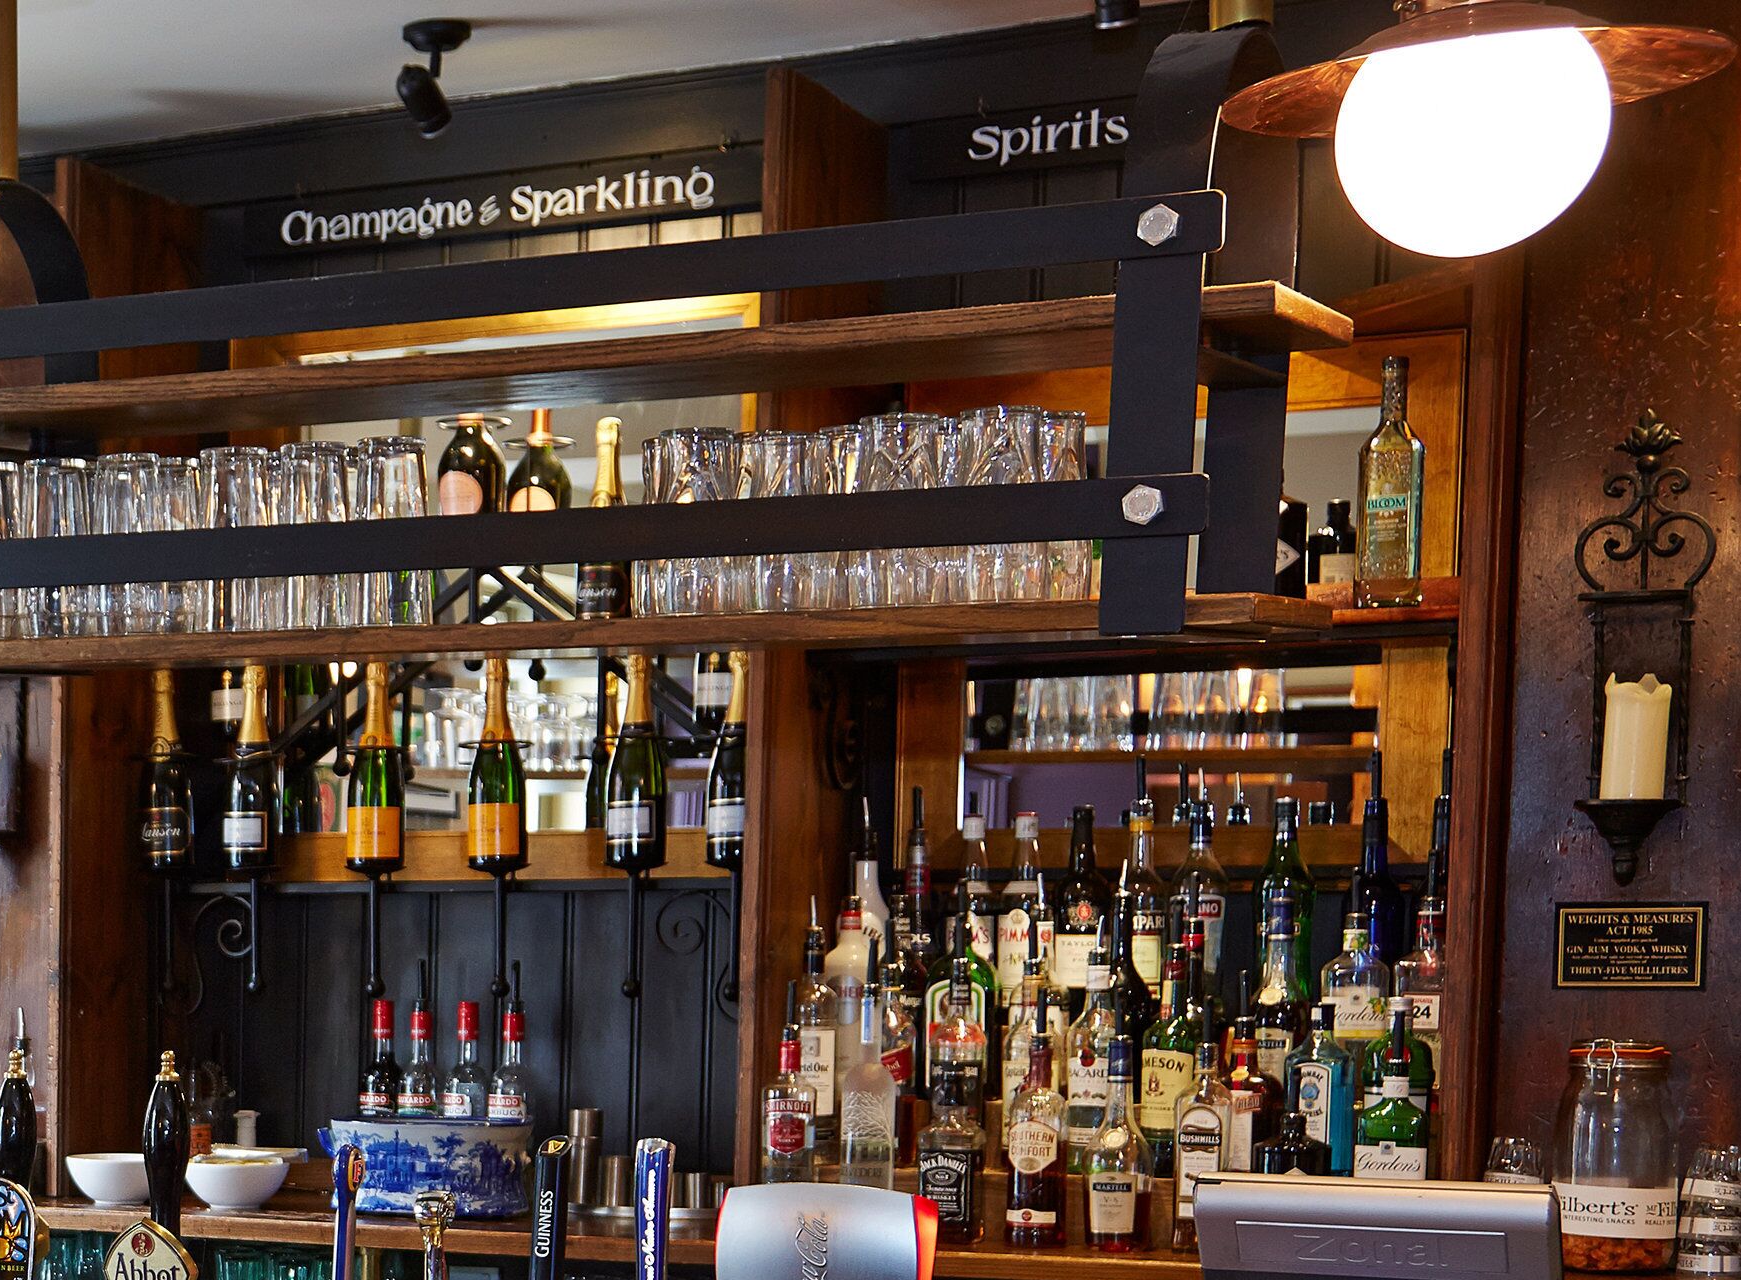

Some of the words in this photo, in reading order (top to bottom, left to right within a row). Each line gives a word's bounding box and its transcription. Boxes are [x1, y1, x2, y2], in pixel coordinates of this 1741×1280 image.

[281, 197, 473, 246] Champagne
[510, 165, 715, 227] Sparkling
[1368, 498, 1406, 509] BLOOM
[141, 822, 180, 841] Lanson
[1568, 914, 1619, 923] WEIGHTS
[1621, 914, 1630, 923] &
[1634, 914, 1694, 923] MEASURES
[999, 928, 1029, 942] PIMM
[1606, 926, 1631, 935] ACT
[1632, 926, 1653, 935] 1985
[1567, 946, 1583, 954] GIN
[1614, 945, 1646, 953] VODKA
[1651, 945, 1688, 953] WHISKY
[1570, 966, 1628, 975] THIRTY-FIVE
[1629, 966, 1689, 975] MILLILITRES
[1413, 1005, 1431, 1019] 24
[1258, 1040, 1284, 1048] ARTELL
[814, 1063, 830, 1072] One
[1301, 1071, 1324, 1083] OMBAY
[1180, 1134, 1220, 1143] BUSHMILLS
[919, 1158, 937, 1172] JACK
[938, 1154, 968, 1174] DANIEL'S
[1358, 1153, 1421, 1173] Gordon's
[1561, 1196, 1638, 1217] ilbert's
[534, 1190, 554, 1258] GUINNESS
[1606, 1217, 1636, 1225] SNACKS
[1293, 1234, 1449, 1267] Zonal
